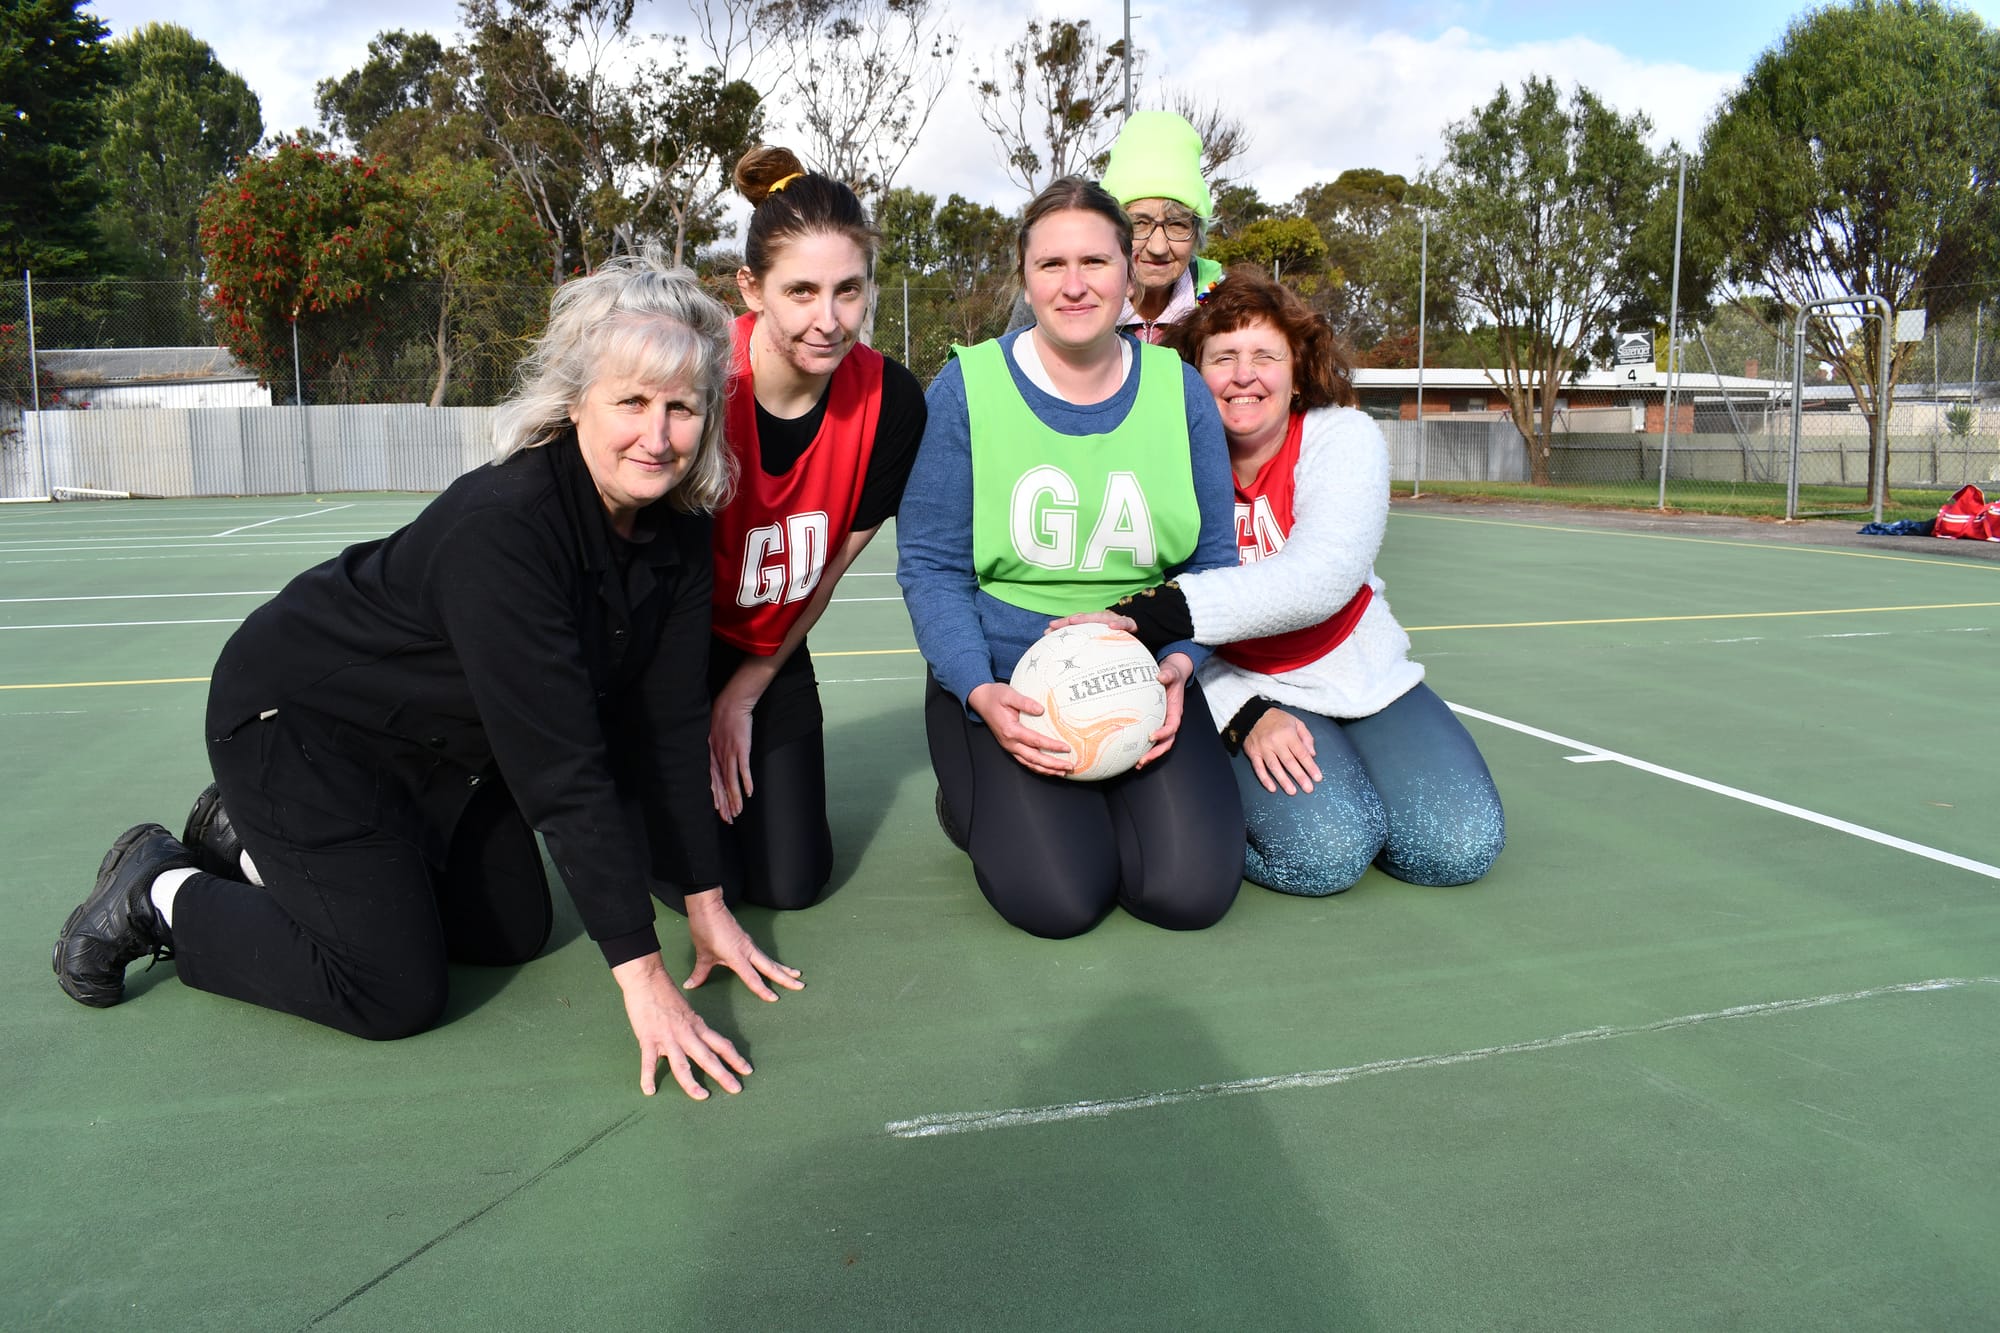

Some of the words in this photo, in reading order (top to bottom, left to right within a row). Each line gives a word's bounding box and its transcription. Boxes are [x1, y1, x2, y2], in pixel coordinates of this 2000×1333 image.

[1628, 369, 1637, 381] 4
[736, 510, 828, 608] GD
[1009, 464, 1157, 572] GA
